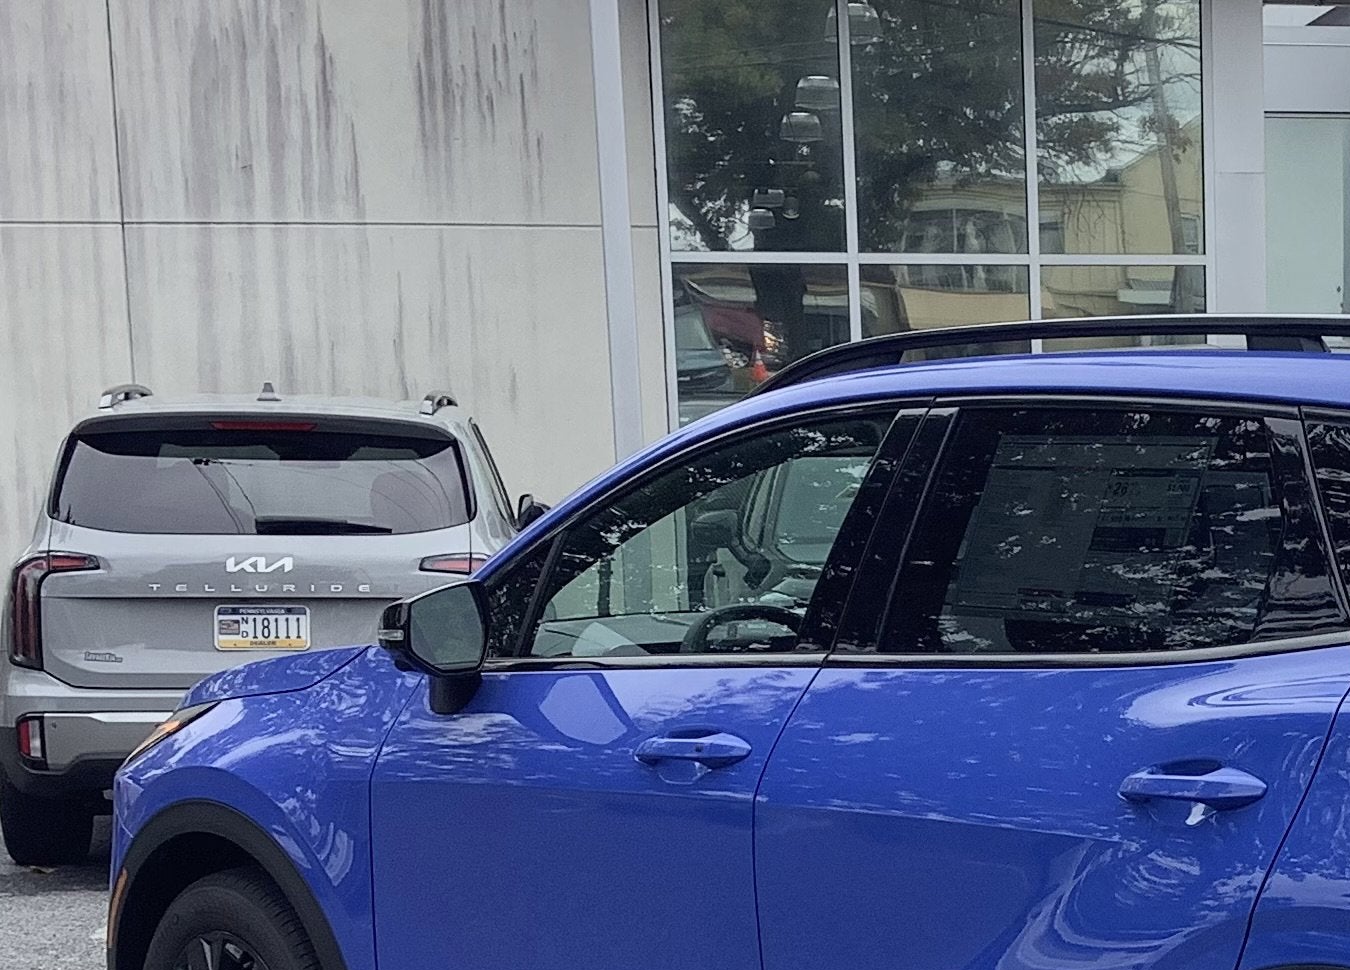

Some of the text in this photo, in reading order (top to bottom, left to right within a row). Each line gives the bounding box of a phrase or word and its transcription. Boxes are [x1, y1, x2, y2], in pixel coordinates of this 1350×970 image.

[225, 556, 294, 573] KIA
[149, 583, 371, 593] TELLURIDE
[252, 617, 302, 639] 18111
